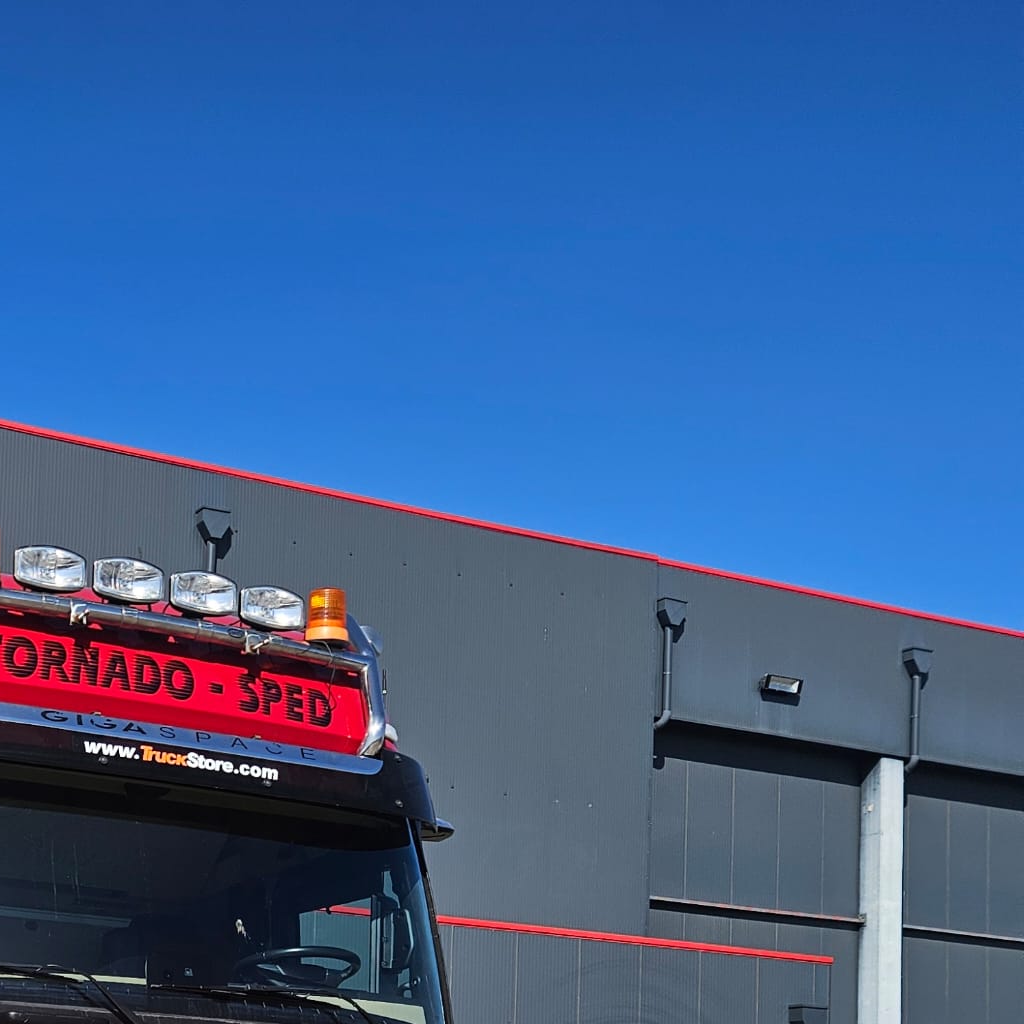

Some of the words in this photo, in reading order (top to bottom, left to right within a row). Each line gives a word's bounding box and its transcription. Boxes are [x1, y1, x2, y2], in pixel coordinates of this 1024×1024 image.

[236, 670, 332, 728] SPED
[40, 709, 318, 761] GIGASPACE
[83, 740, 280, 781] www.TruckStore.com
